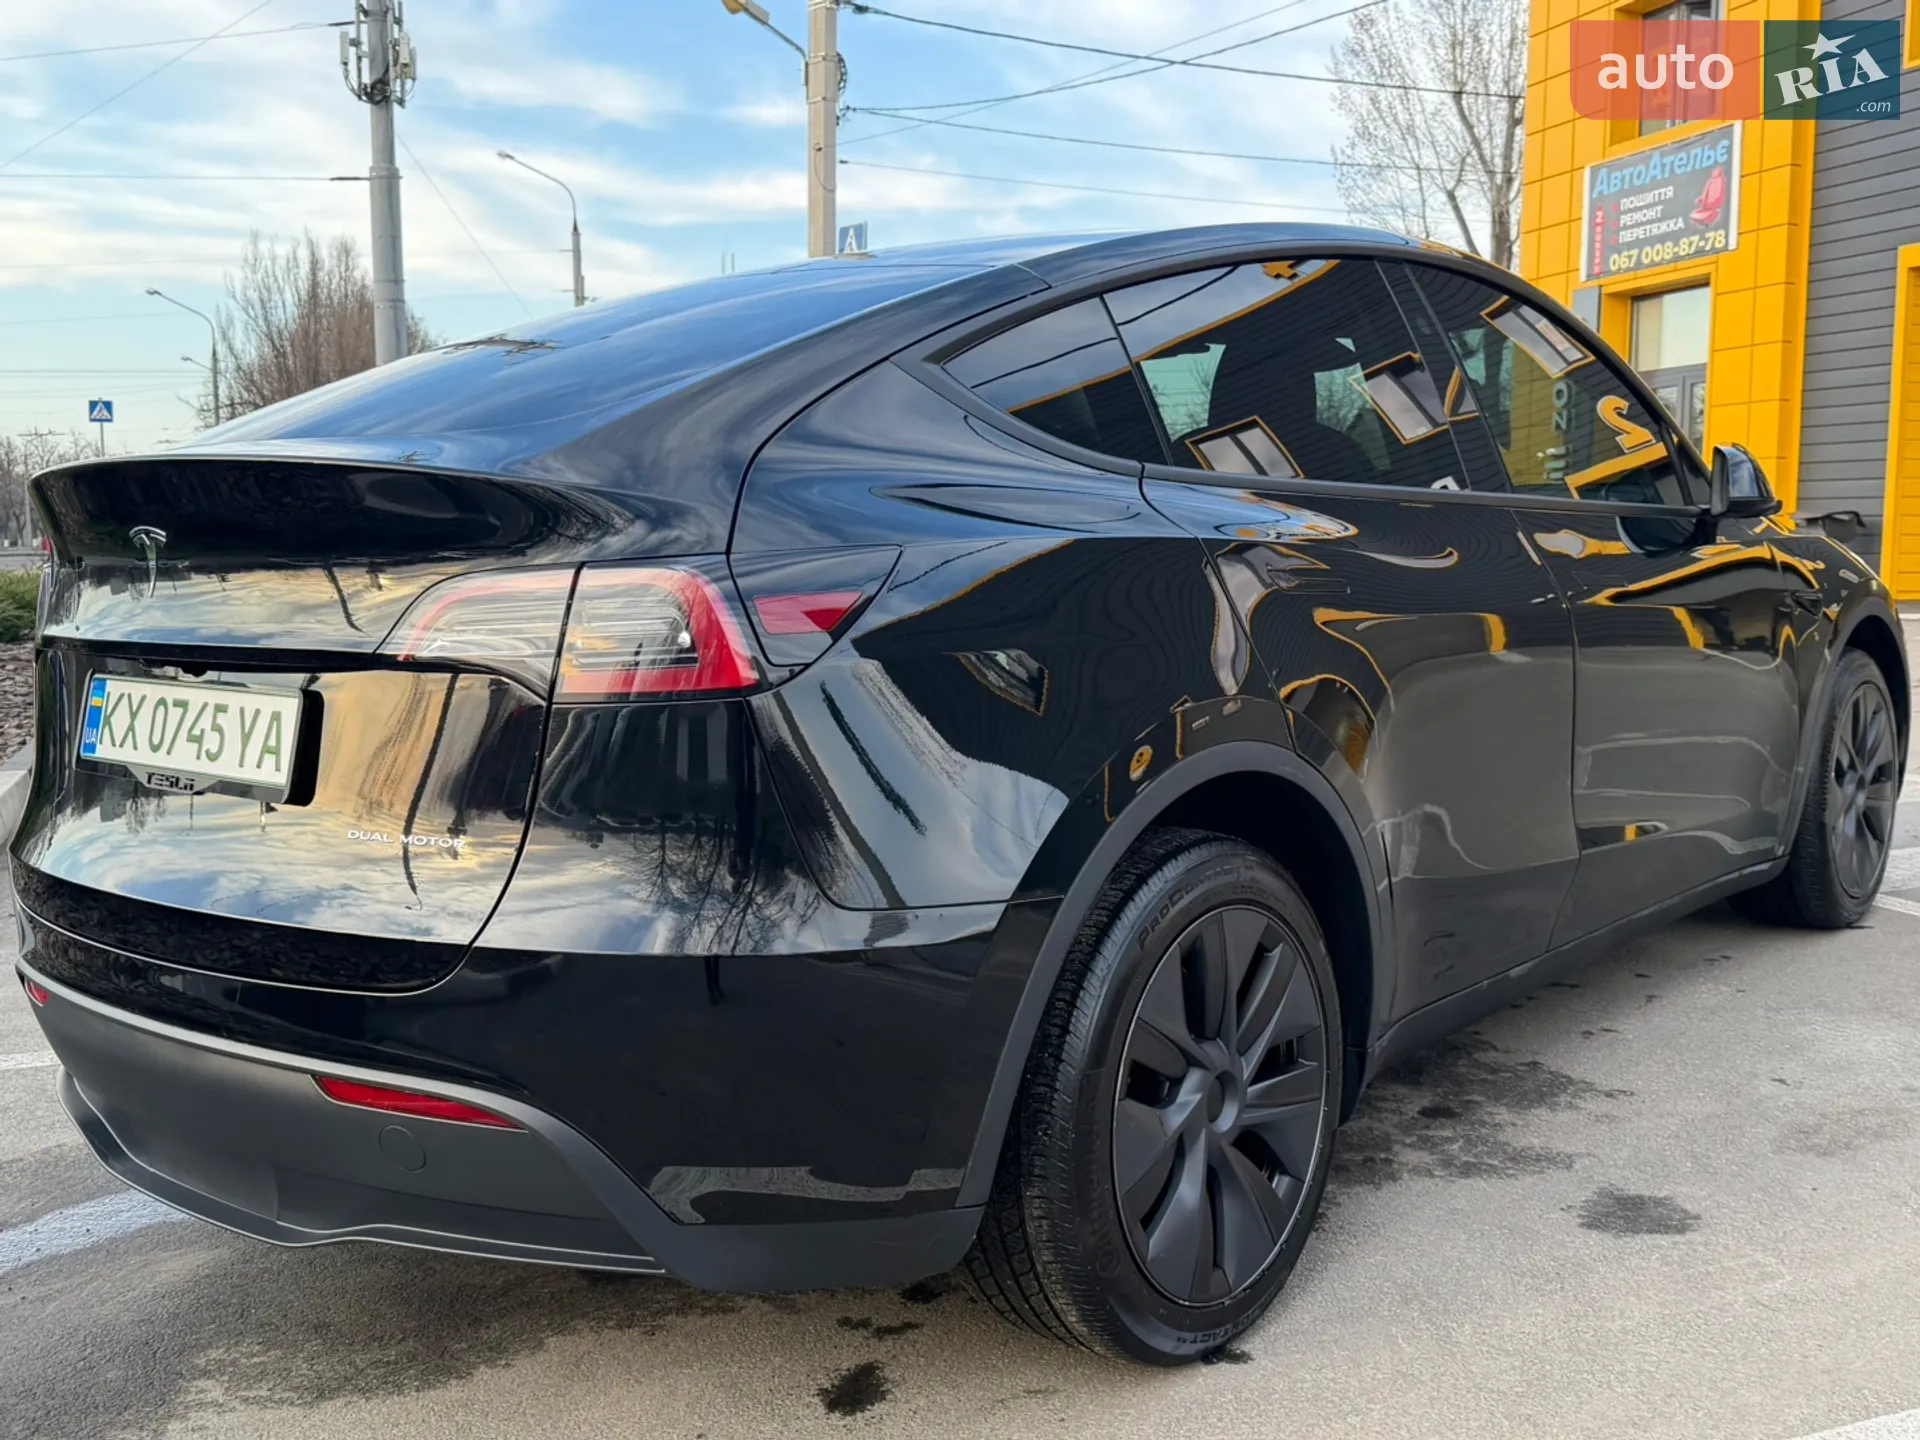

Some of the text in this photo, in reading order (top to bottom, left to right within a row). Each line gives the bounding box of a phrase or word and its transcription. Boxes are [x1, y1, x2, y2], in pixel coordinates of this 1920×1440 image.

[1620, 185, 1673, 211] ПОШИТТЯ
[1619, 205, 1662, 227] РЕМОНТ
[1618, 216, 1684, 243] ПЕРЕТЯЖКА
[1610, 249, 1639, 271] 067
[1641, 229, 1726, 264] 008-87-78
[84, 727, 97, 744] UA
[347, 829, 466, 849] DUAL MOTOR
